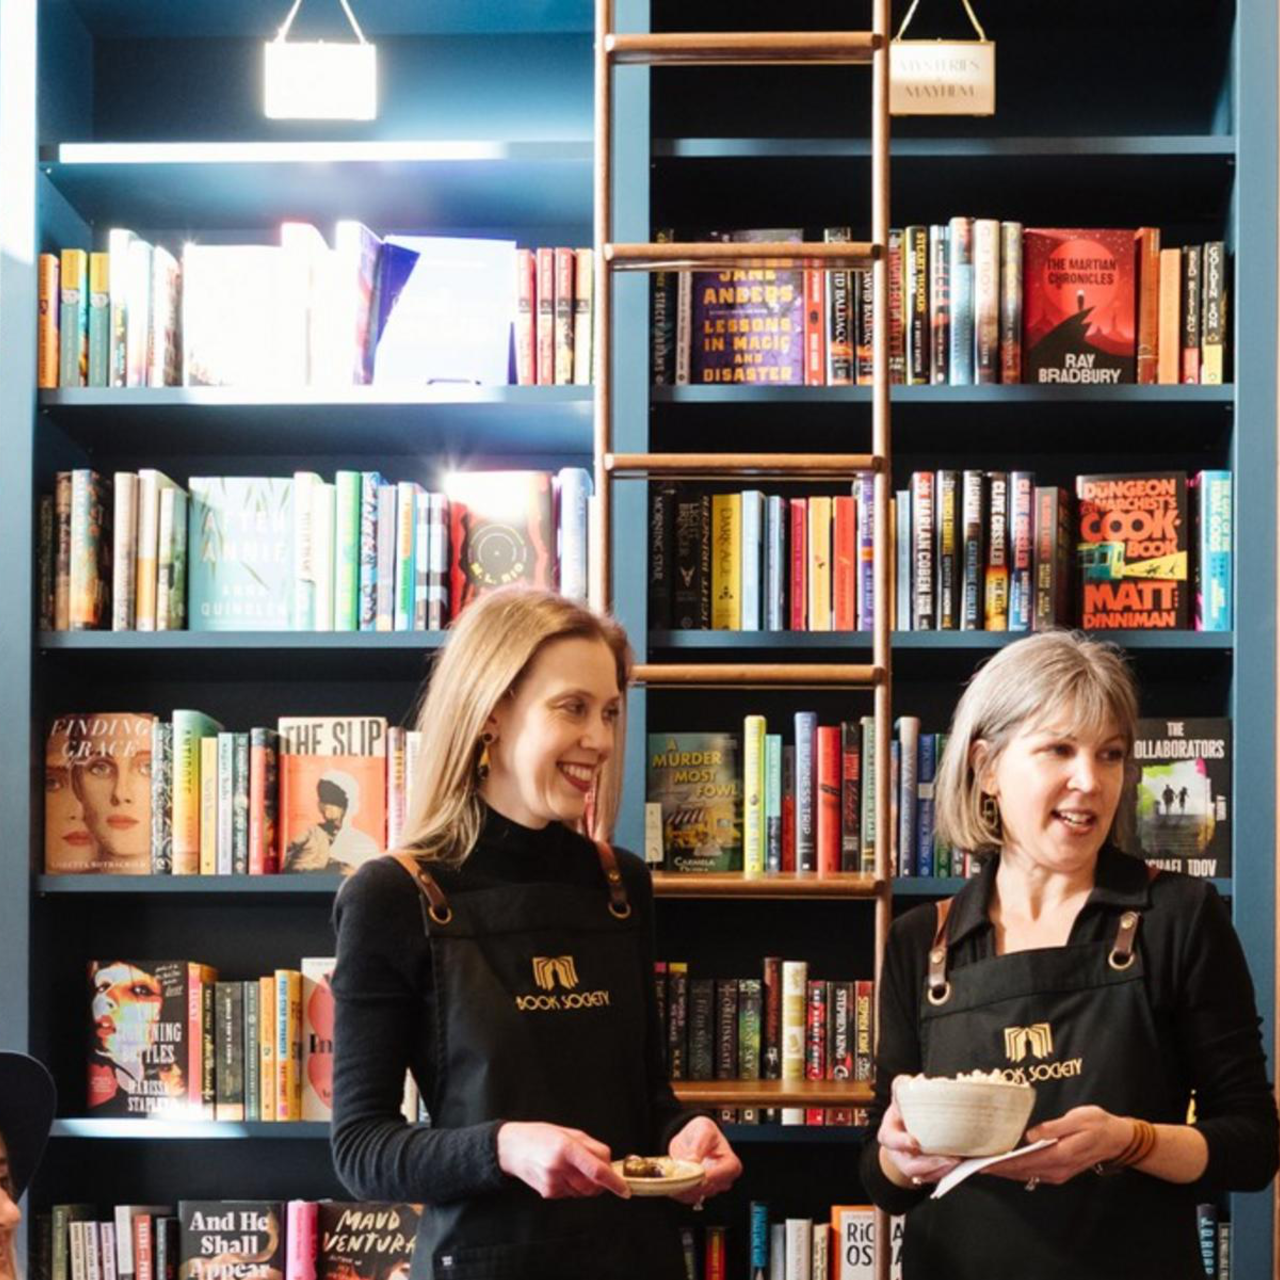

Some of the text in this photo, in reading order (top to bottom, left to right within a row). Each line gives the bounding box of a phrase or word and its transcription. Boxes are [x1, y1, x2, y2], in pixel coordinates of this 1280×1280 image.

[904, 85, 975, 98] MAYHEM
[1047, 258, 1116, 270] THE MARTIAN
[1048, 272, 1114, 285] CHRONICLES
[703, 286, 793, 305] ANDERS
[703, 318, 792, 333] LESSONS
[704, 336, 790, 351] IN MAGIC
[734, 354, 763, 364] AND
[1065, 353, 1095, 368] RAY
[703, 368, 793, 383] DISASTER
[1038, 369, 1120, 383] BRADBURY
[1082, 477, 1176, 500] DUNGEON
[720, 507, 733, 546] DARK
[991, 480, 1005, 566] CLIVE CUSSLER
[1081, 511, 1180, 543] COOK-
[653, 496, 663, 580] MORNING STAR
[918, 499, 931, 592] HARLAN COBEN
[1127, 539, 1177, 556] BOOK
[1083, 582, 1172, 612] MATT
[1082, 612, 1176, 630] DINNIMAN
[51, 718, 151, 738] FINDING
[1167, 722, 1184, 737] THE
[283, 721, 383, 756] THE SLIP
[667, 739, 677, 751] A
[62, 741, 139, 760] GRACE
[1134, 740, 1225, 759] OLLABORATORS
[653, 752, 722, 768] MURDER
[674, 771, 716, 785] MOST
[801, 743, 811, 806] BUSINESS
[697, 783, 738, 798] FOWL
[801, 808, 811, 835] TRIP
[516, 990, 610, 1011] BOOK SOCIETY
[722, 998, 731, 1069] OBELISK GATE
[836, 989, 846, 1058] STEPHEN KING
[858, 996, 869, 1053] STEPHEN KING
[745, 1009, 754, 1069] STONE SKY
[1028, 1058, 1083, 1083] SOCIETY
[189, 1211, 268, 1231] And He
[338, 1209, 401, 1232] MAUD
[201, 1235, 258, 1255] Shall
[324, 1232, 418, 1254] VENTURA
